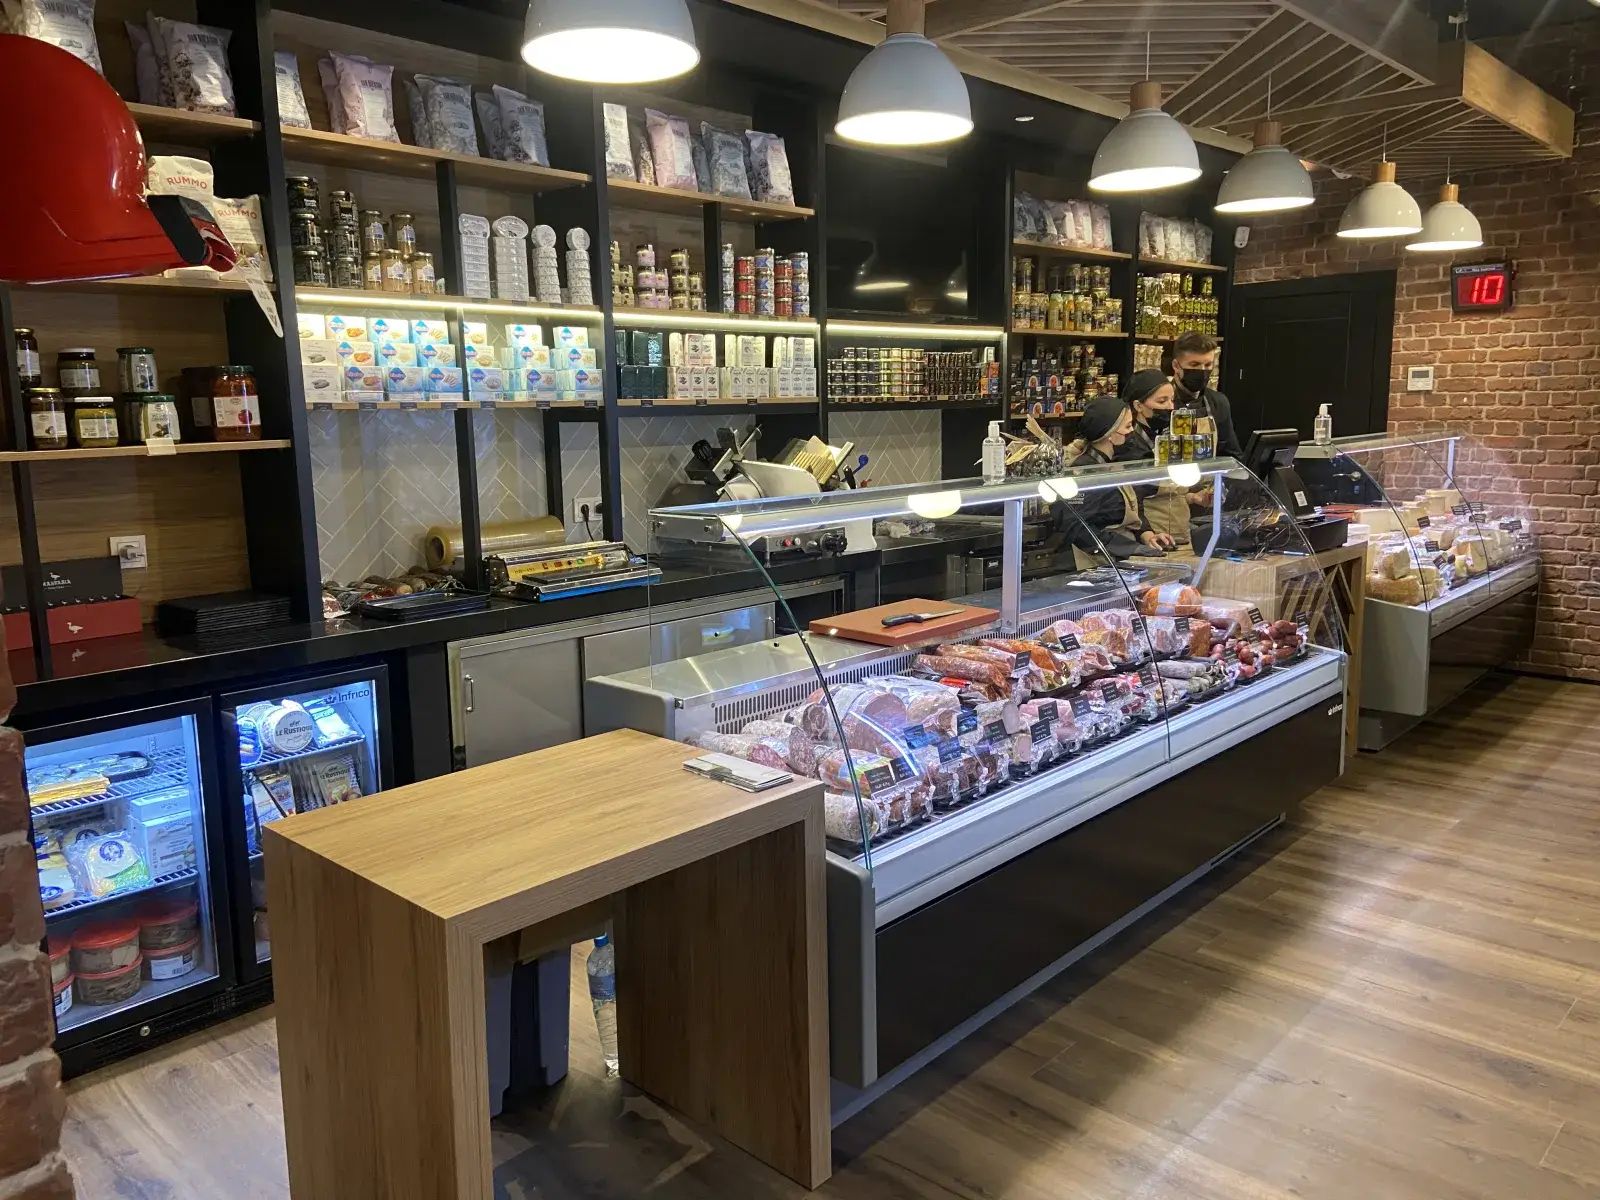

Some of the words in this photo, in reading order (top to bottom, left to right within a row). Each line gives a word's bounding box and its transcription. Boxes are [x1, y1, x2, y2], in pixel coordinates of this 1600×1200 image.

[166, 176, 208, 190] RUMMO
[217, 208, 258, 220] RUMMO
[1472, 275, 1504, 303] 10
[338, 689, 370, 702] Infrico
[275, 729, 283, 737] LE
[283, 724, 314, 735] RUSTIQUE
